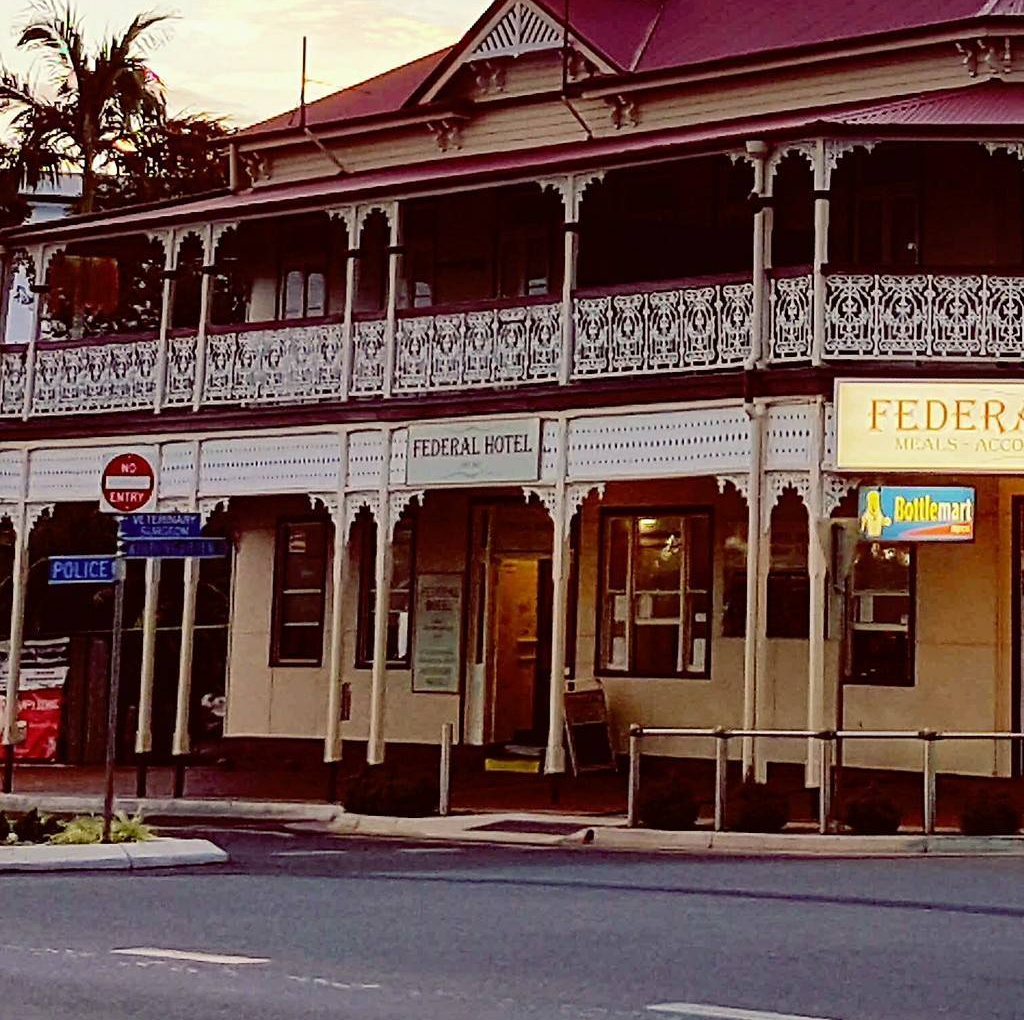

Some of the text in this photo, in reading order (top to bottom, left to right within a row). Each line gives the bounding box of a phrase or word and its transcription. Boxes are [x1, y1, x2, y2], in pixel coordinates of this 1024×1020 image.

[413, 433, 532, 458] FEDERAL HOTEL
[894, 437, 959, 451] MEALS
[121, 462, 137, 474] NO
[109, 491, 145, 503] ENTRY
[893, 494, 974, 523] Bottlemart
[132, 514, 197, 525] VETERINARY
[52, 560, 110, 580] POLICE
